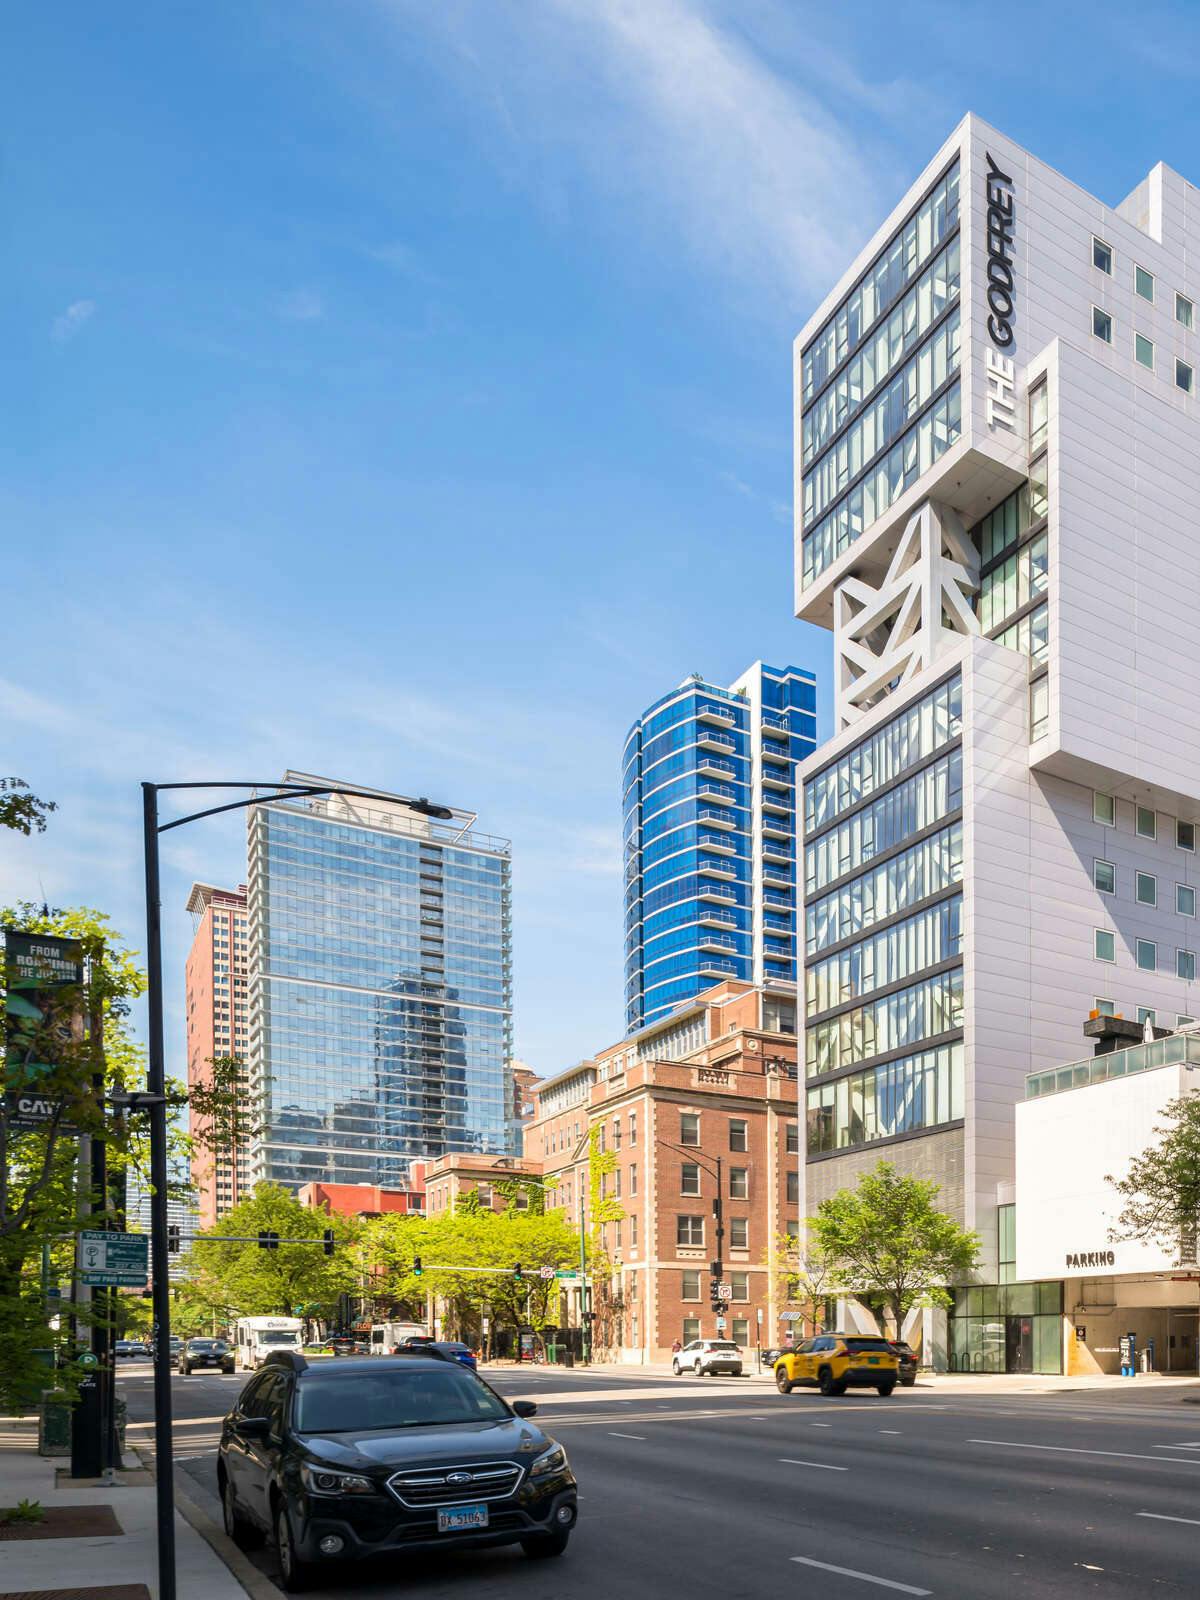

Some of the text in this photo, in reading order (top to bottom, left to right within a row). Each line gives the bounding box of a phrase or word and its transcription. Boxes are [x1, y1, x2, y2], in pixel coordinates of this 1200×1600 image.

[986, 152, 1014, 428] THE GODFREY
[30, 945, 60, 958] FROM
[18, 1099, 60, 1115] CAT
[1065, 1250, 1115, 1268] PARKING
